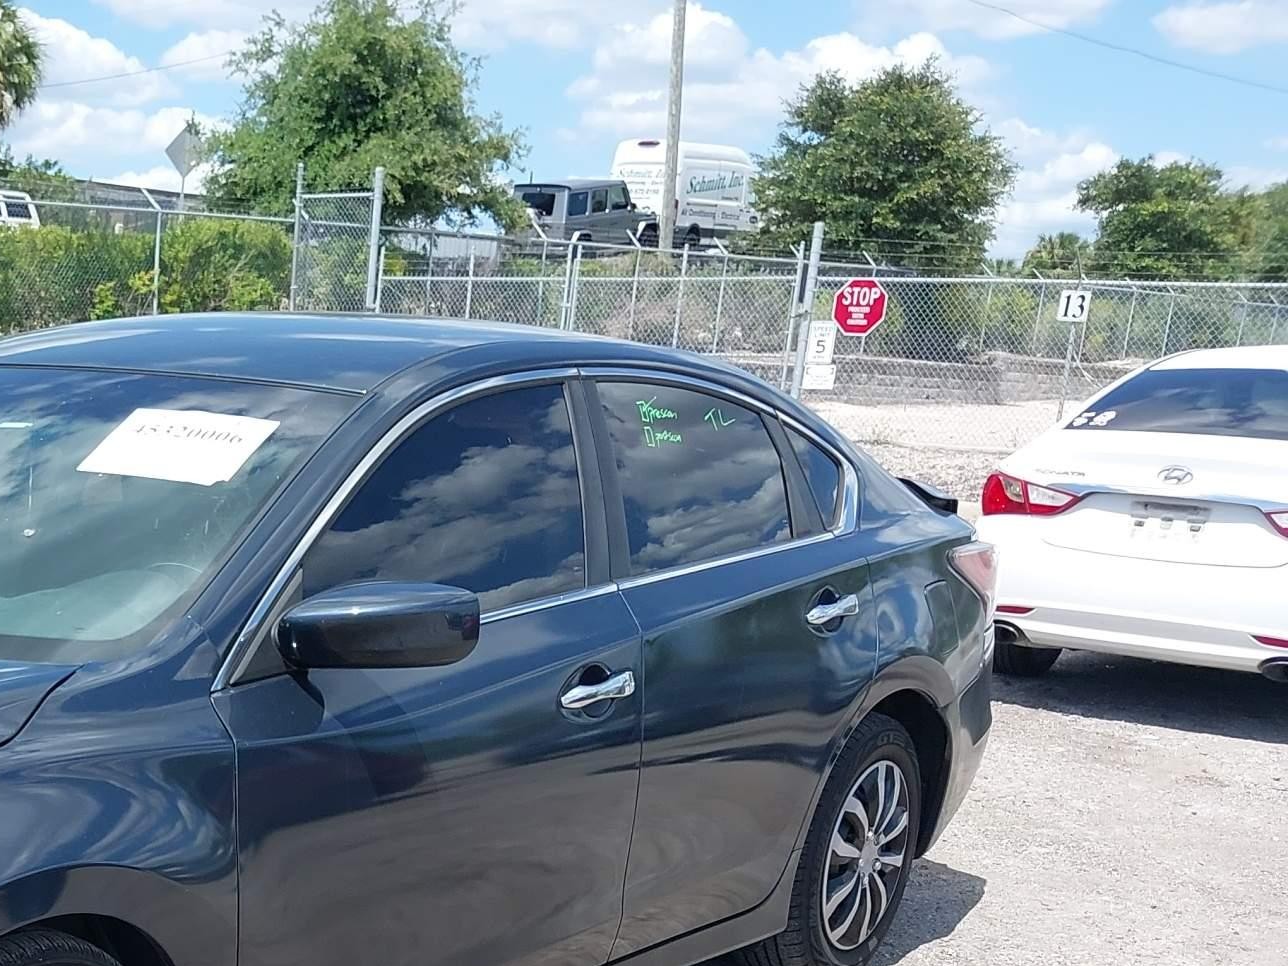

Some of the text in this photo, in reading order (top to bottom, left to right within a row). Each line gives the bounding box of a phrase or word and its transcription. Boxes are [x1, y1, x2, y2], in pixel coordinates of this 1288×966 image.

[842, 287, 881, 306] STOP
[1063, 294, 1086, 319] 13
[815, 340, 826, 354] 5
[704, 407, 736, 431] TL
